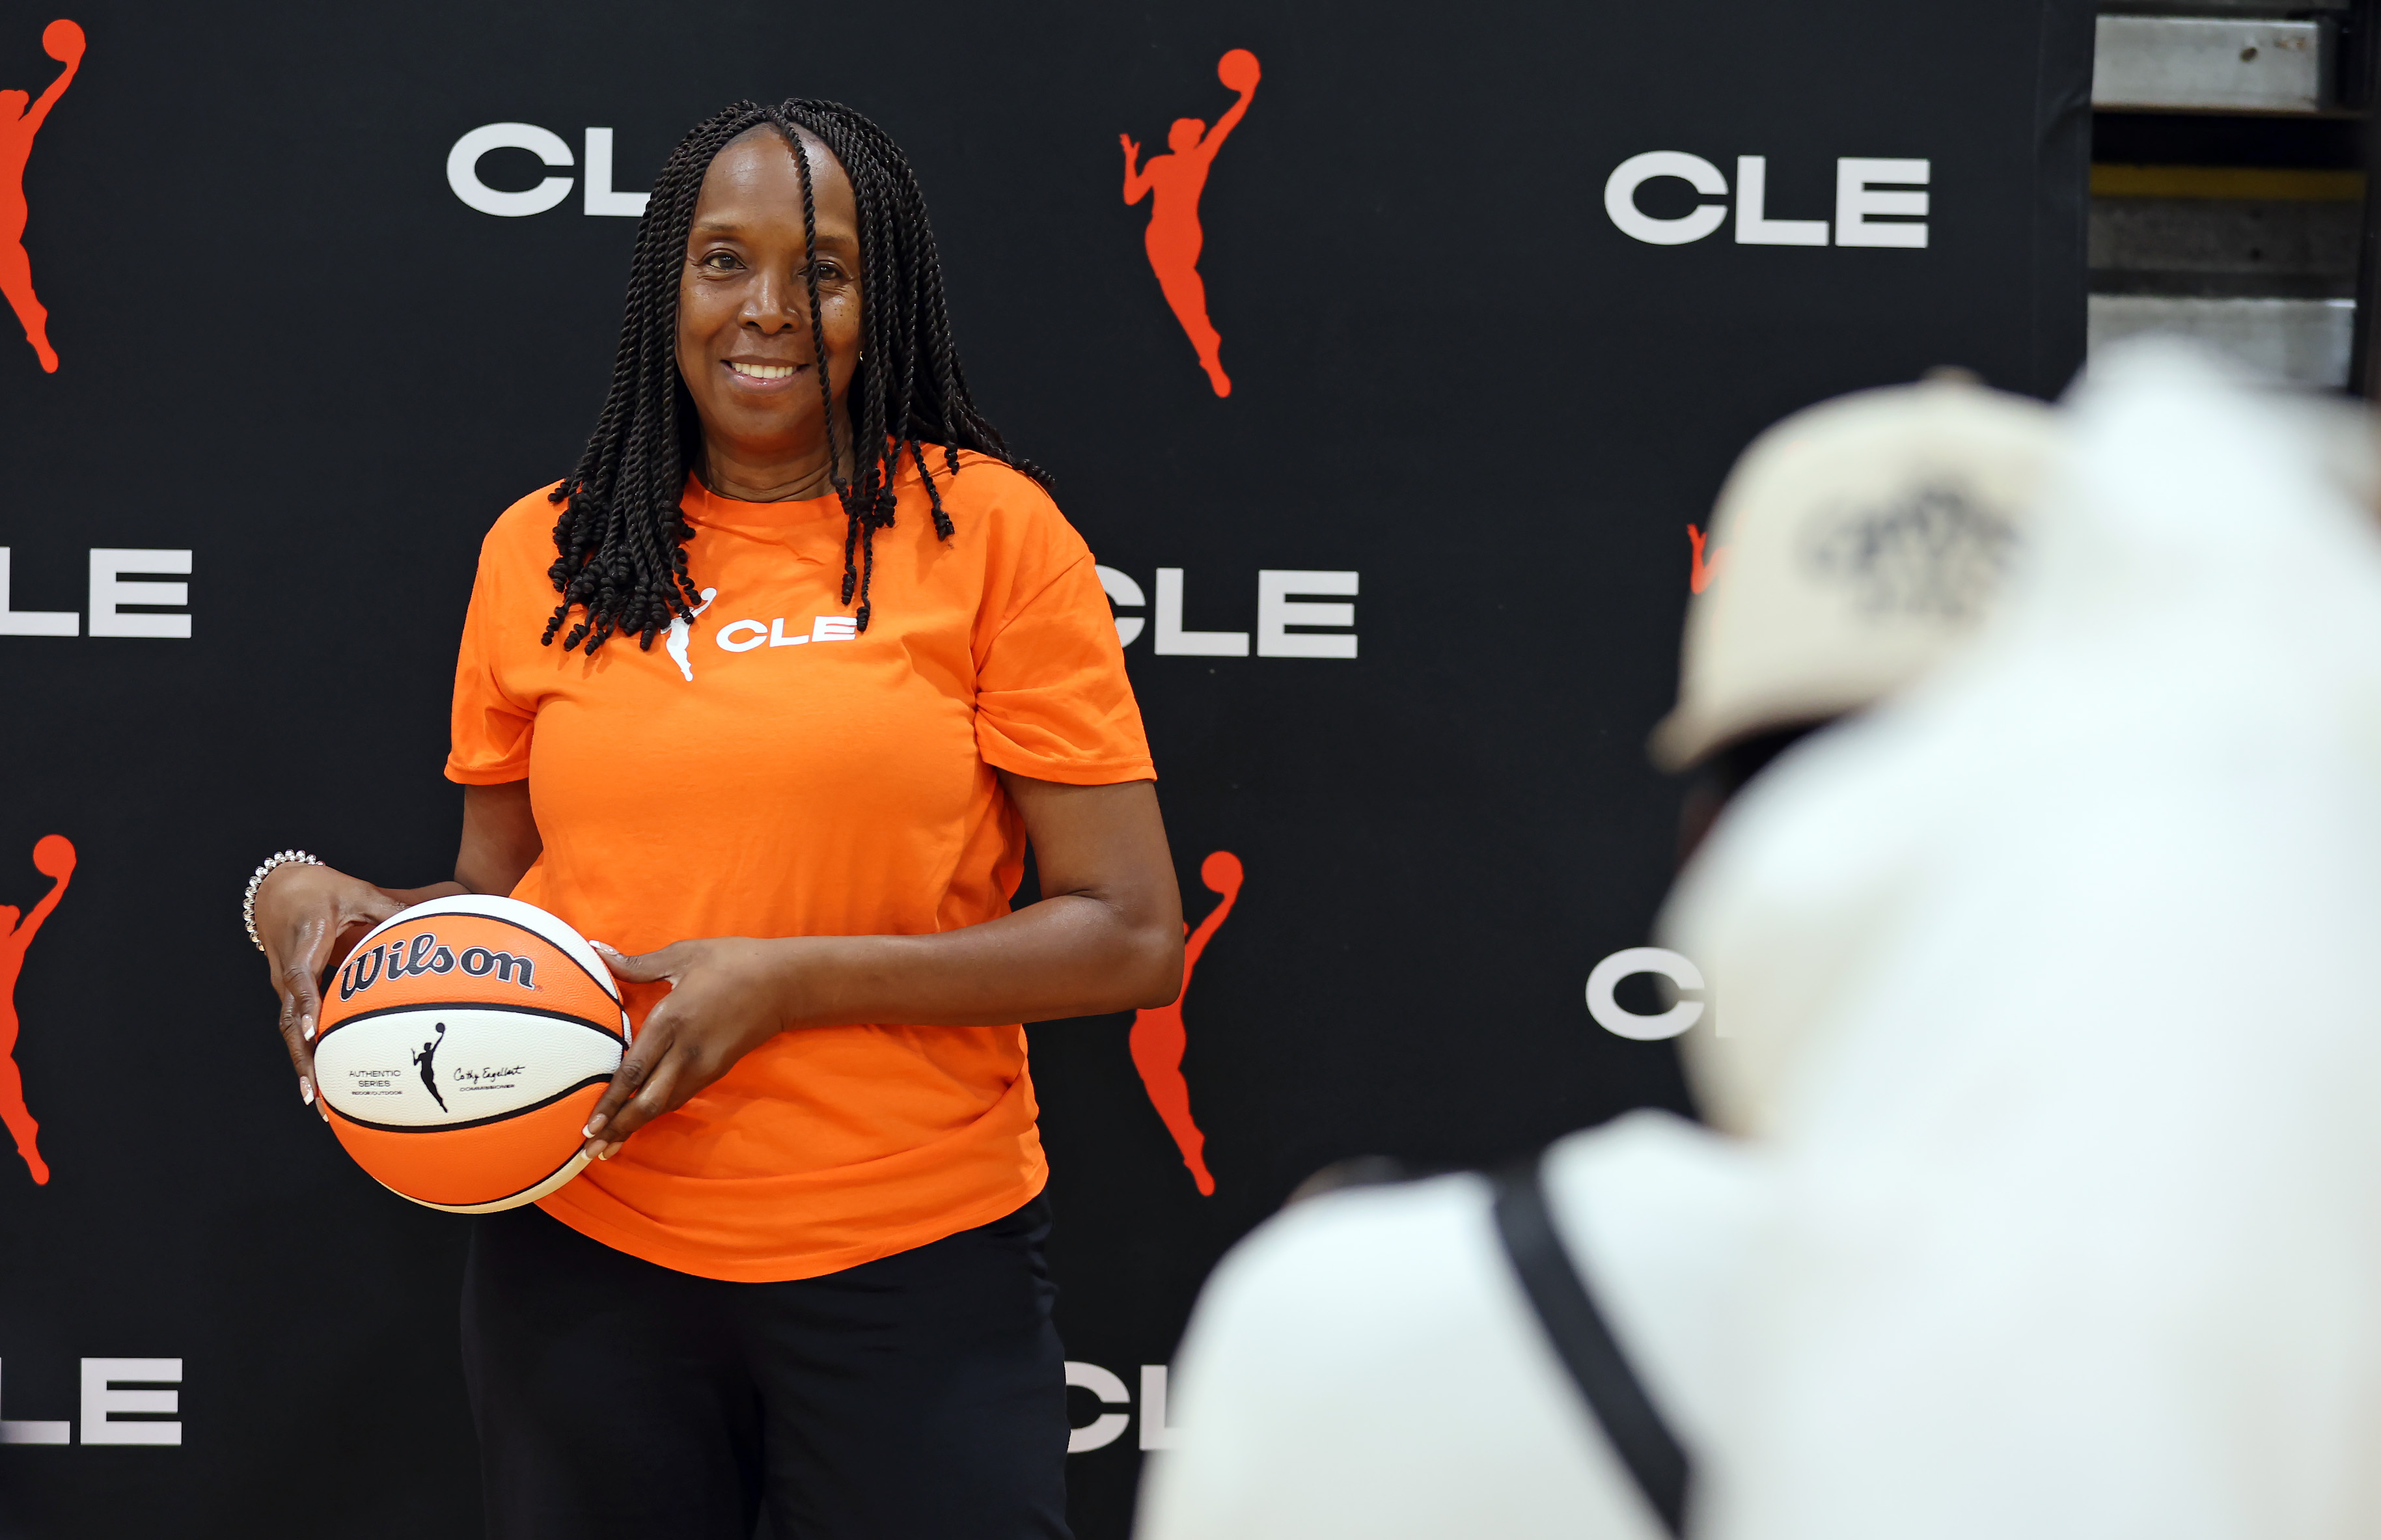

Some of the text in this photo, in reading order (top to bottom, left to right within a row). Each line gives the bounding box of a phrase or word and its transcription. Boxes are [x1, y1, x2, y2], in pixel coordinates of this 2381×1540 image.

[447, 122, 651, 217] CL
[1604, 150, 1931, 249] CLE
[0, 546, 193, 639] LE
[716, 616, 857, 652] CLE
[339, 932, 536, 1002] Wilson
[0, 1357, 182, 1446] LE
